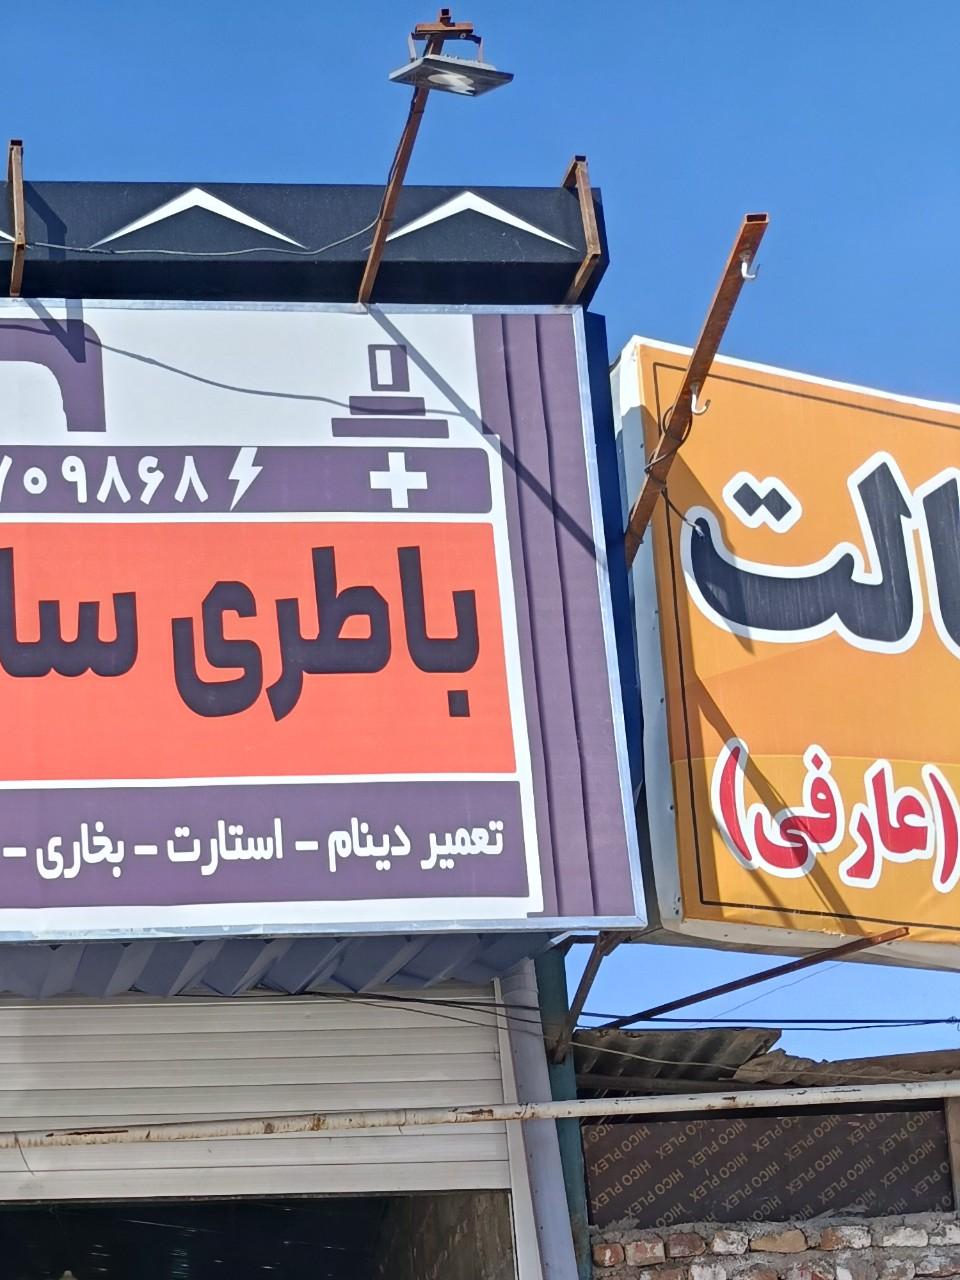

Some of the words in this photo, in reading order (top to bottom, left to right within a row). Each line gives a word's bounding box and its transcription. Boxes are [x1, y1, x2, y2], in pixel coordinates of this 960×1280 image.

[171, 546, 481, 721] باطری
[35, 820, 125, 881] بخاری
[166, 817, 284, 877] استارت
[327, 816, 411, 873] دینام
[420, 820, 504, 871] تعمیر
[621, 1126, 651, 1152] HICO
[718, 1119, 747, 1145] HICO
[751, 1124, 783, 1153] PLEX
[590, 1148, 623, 1176] PLEX
[687, 1141, 719, 1168] PLEX
[719, 1152, 748, 1178] HICO
[815, 1145, 844, 1171] HICO
[907, 1139, 936, 1165] HICO
[622, 1160, 652, 1186] HICO
[751, 1161, 780, 1187] HICO
[846, 1154, 875, 1180] HICO
[654, 1169, 685, 1195] HICO
[689, 1174, 720, 1202] PLEX
[785, 1167, 816, 1195] PLEX
[817, 1177, 848, 1206] PLEX
[591, 1182, 623, 1210] PLEX
[624, 1191, 656, 1217] PLEX
[721, 1184, 753, 1212] PLEX
[753, 1195, 782, 1220] HICO
